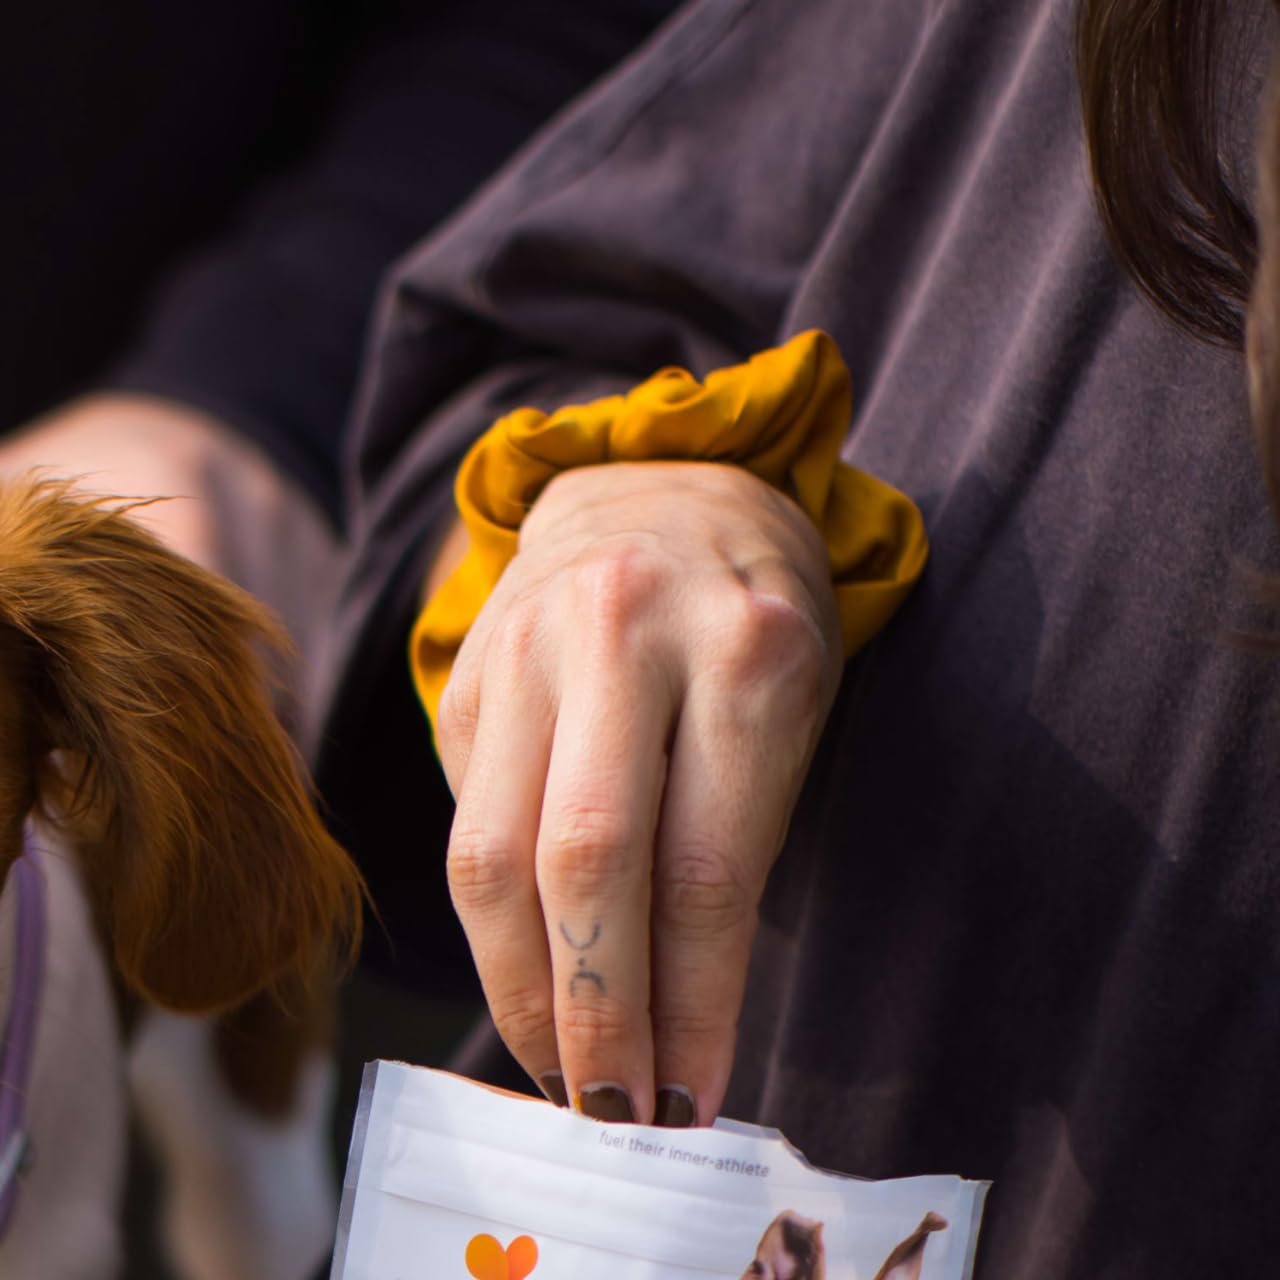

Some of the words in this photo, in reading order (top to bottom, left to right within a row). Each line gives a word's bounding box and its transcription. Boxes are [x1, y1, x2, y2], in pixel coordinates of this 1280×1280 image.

[599, 1130, 625, 1149] fuel
[629, 1138, 665, 1157] their
[669, 1145, 770, 1177] inner-athlete
